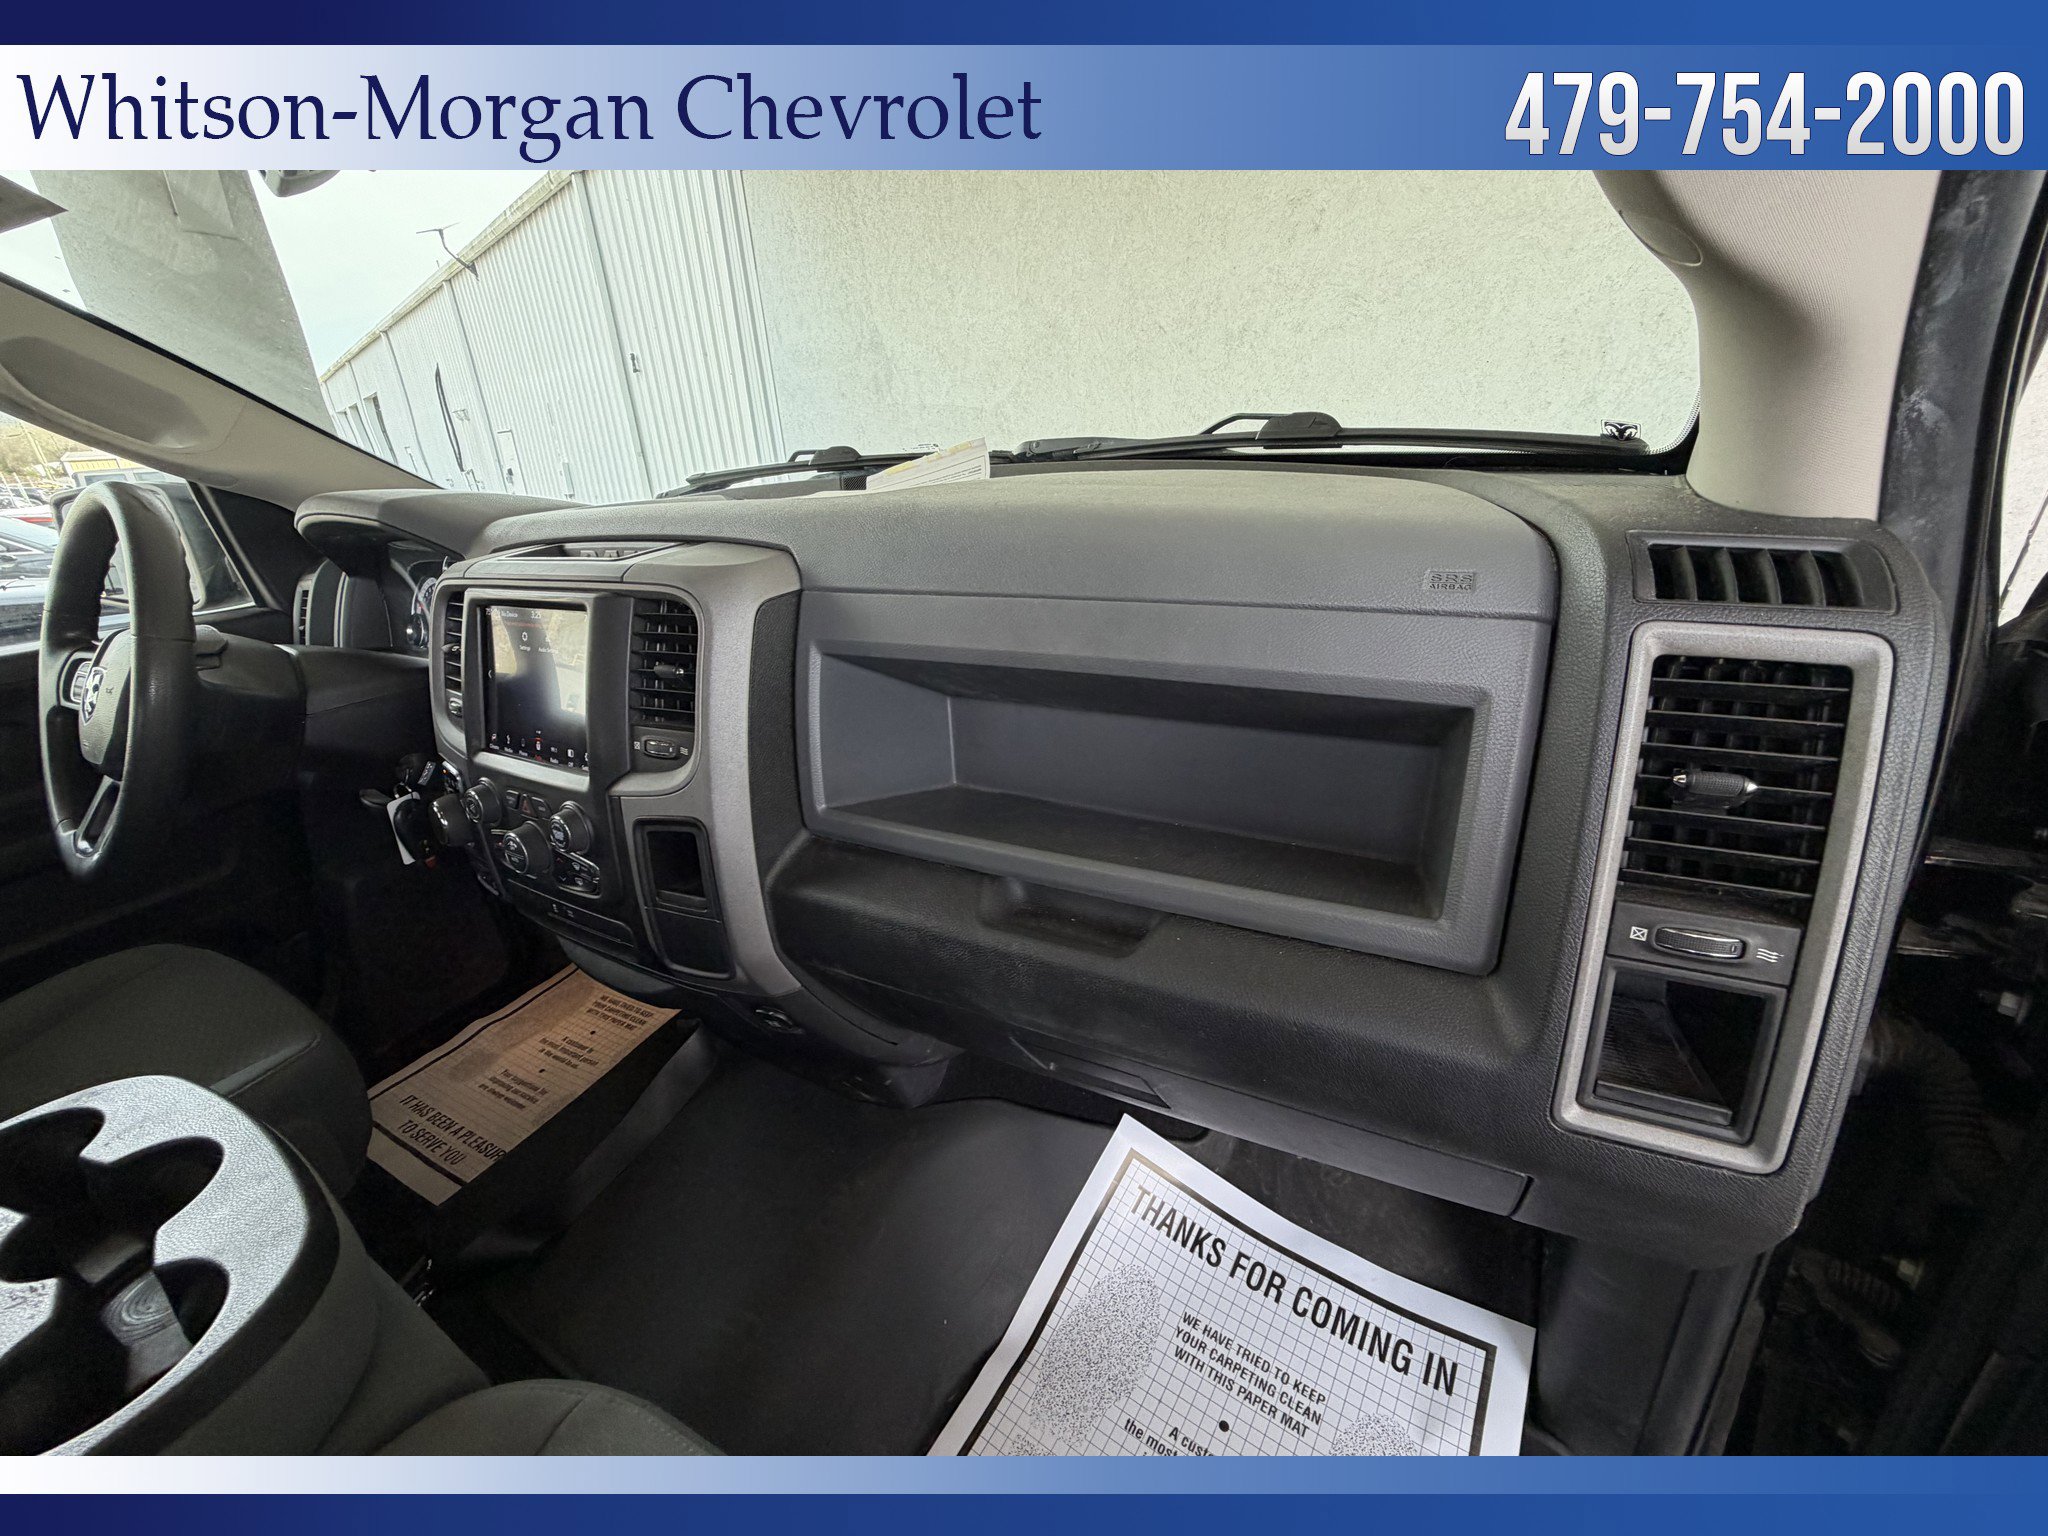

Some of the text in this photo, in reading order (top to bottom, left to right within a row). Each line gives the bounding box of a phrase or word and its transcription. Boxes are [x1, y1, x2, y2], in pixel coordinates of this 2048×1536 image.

[398, 1120, 468, 1165] TO SERVE YOU
[400, 1094, 418, 1106] IT
[409, 1100, 435, 1118] HAS
[426, 1111, 459, 1132] BEEN
[449, 1126, 465, 1137] A
[1131, 1185, 1459, 1397] THANKS FOR COMING IN
[1175, 1345, 1310, 1438] WITH THIS PAPER MAT
[1176, 1326, 1321, 1425] YOUR CARPETING CLEAN
[1183, 1312, 1326, 1405] WE HAVE TRIED TO KEEP
[1124, 1418, 1144, 1439] the
[1168, 1426, 1180, 1441] A
